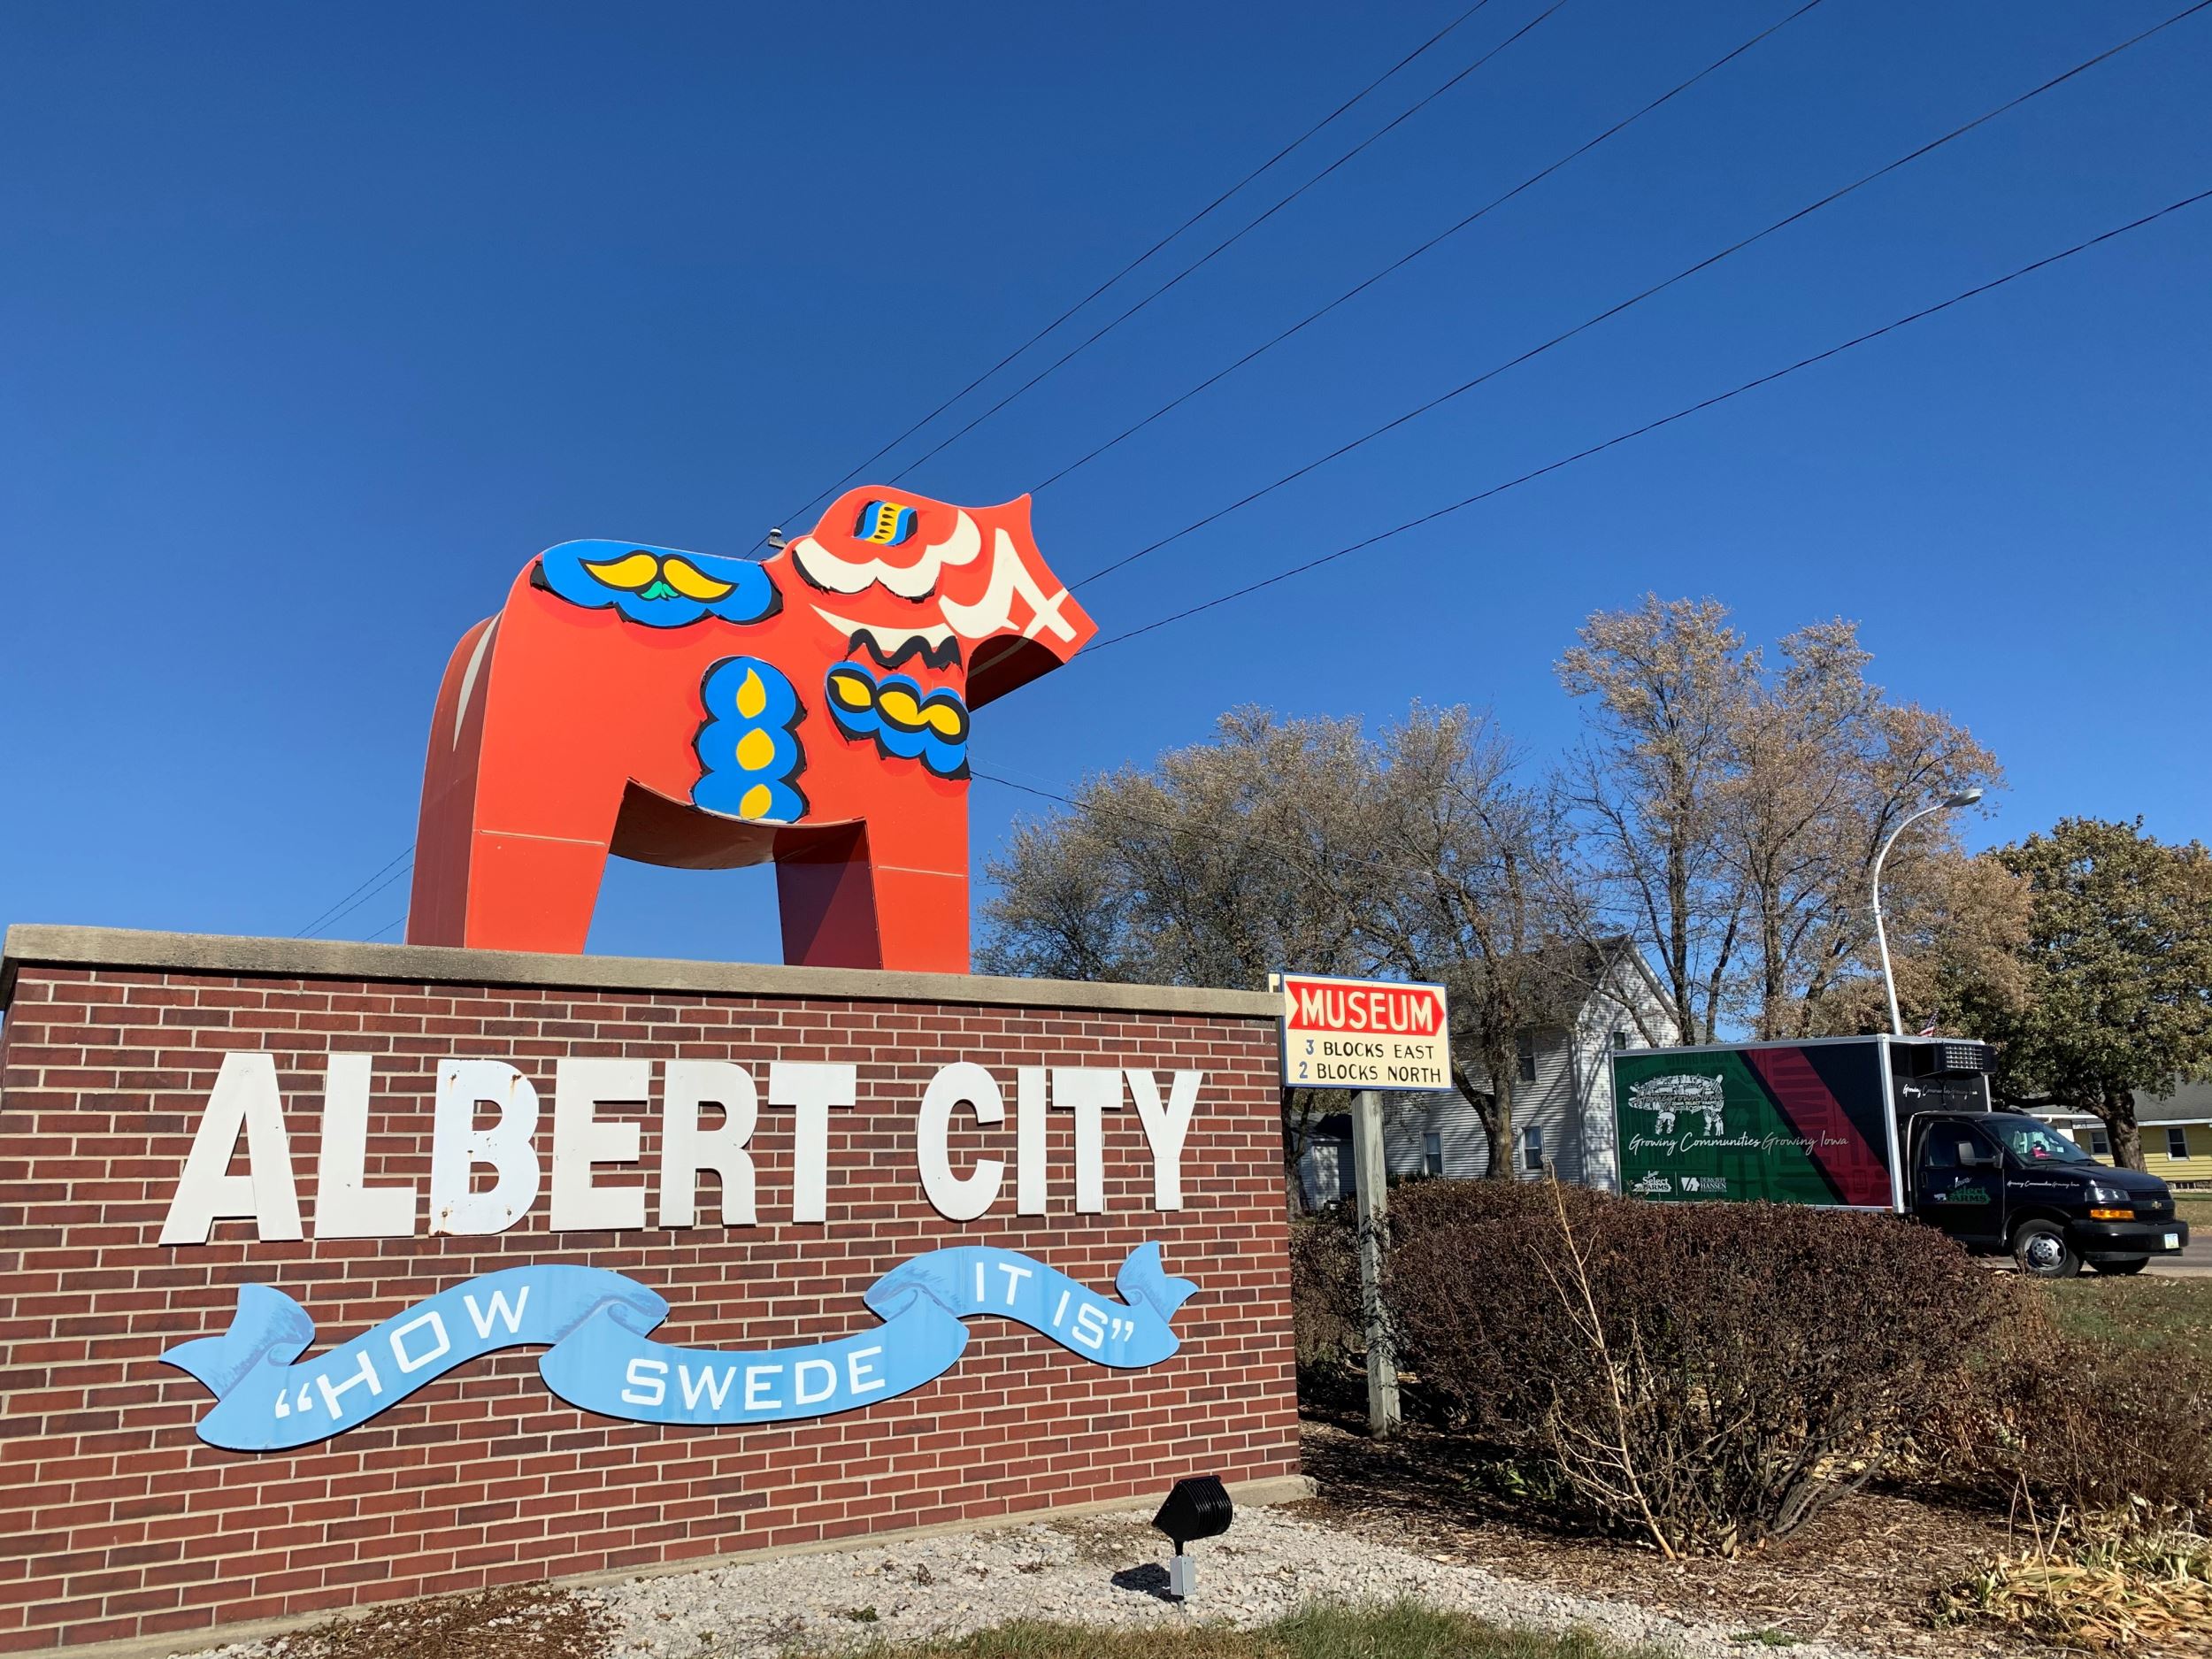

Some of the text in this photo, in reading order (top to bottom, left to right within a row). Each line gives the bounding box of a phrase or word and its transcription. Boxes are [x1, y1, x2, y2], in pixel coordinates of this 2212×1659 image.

[1301, 987, 1432, 1033] MUSEUM
[1305, 1039, 1434, 1060] 3 BLOCKS EAST
[1298, 1061, 1441, 1083] 2 BLOCKS NORTH
[158, 1051, 1203, 1245] ALBERT CITY
[1628, 1133, 1678, 1156] Growing
[1679, 1131, 1761, 1153] Communities
[1762, 1131, 1818, 1156] Growing
[1820, 1130, 1849, 1148] Iowa
[1642, 1176, 1669, 1185] Select
[621, 1345, 887, 1410] SWEDE
[974, 1261, 1033, 1306] IT
